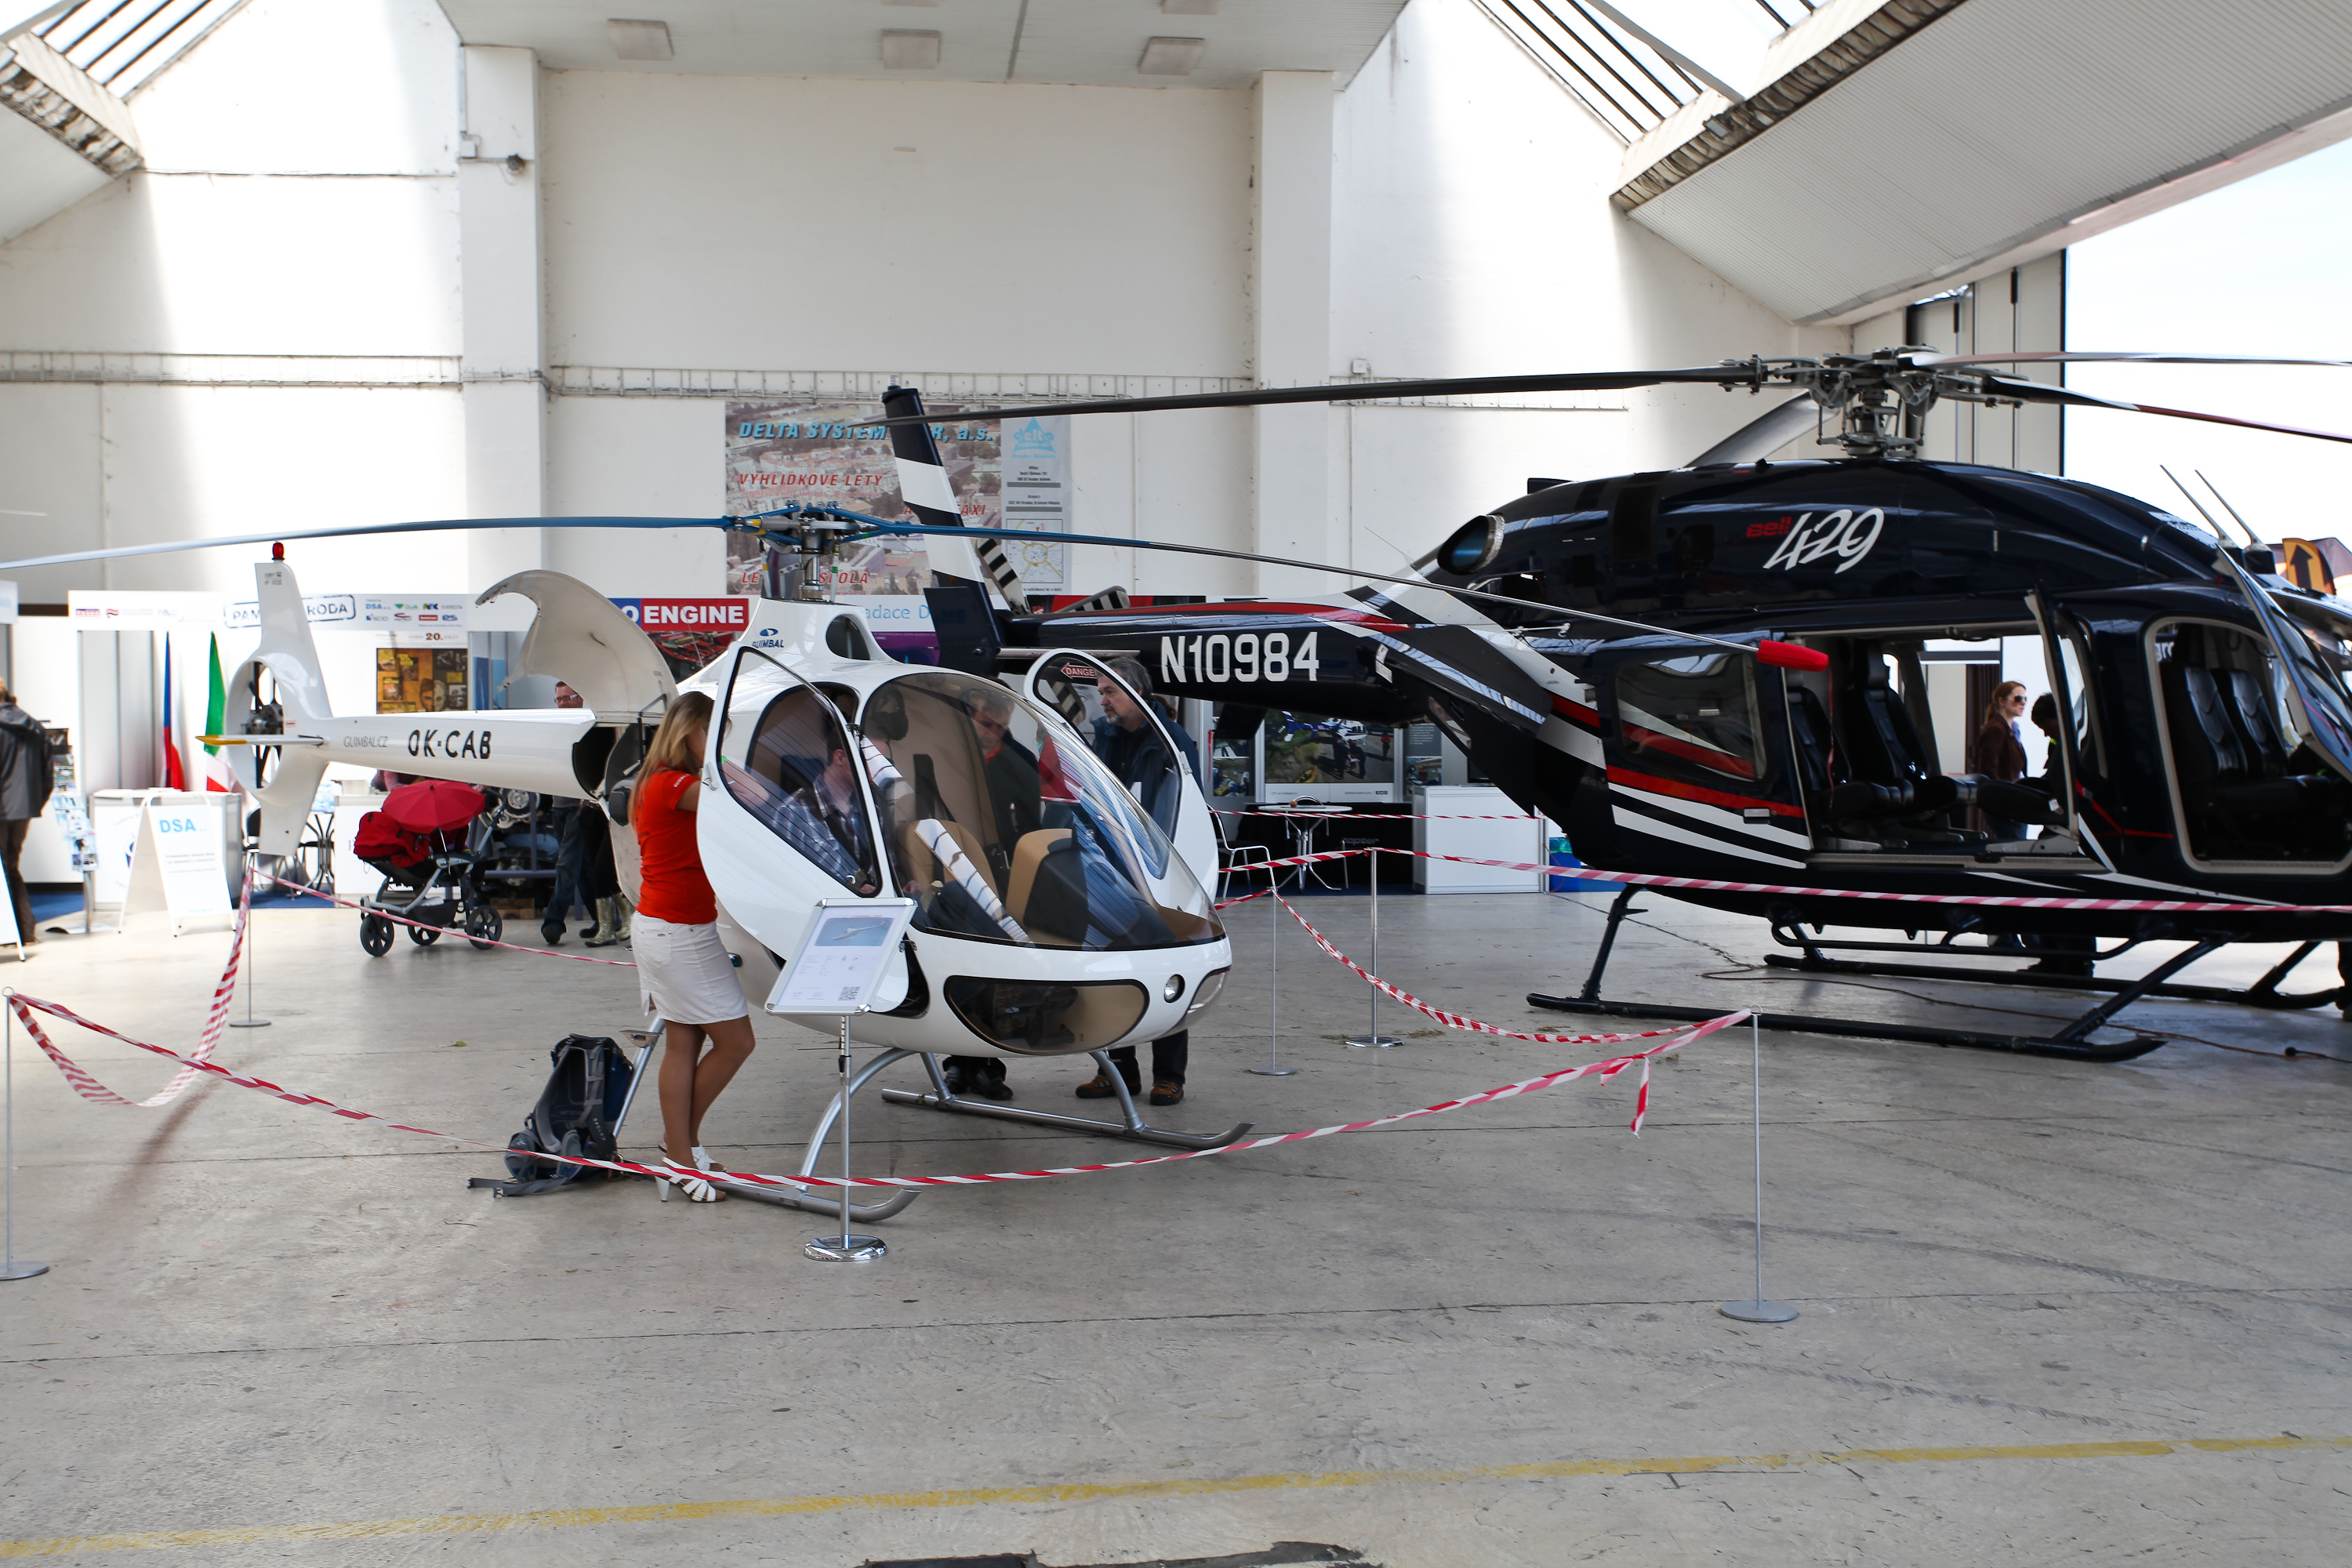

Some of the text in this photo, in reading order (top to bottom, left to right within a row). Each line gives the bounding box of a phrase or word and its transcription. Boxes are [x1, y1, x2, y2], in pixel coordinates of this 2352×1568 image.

[739, 422, 798, 438] DELTA
[956, 428, 993, 441] a.s.
[845, 474, 884, 486] LETY
[1746, 508, 1885, 575] Bell 429
[307, 603, 348, 615] RODA
[644, 605, 744, 624] ENGINE
[752, 639, 784, 648] GUIMBAL
[1161, 631, 1319, 683] N10984
[1065, 667, 1096, 677] DANGE
[159, 818, 196, 833] DSA
